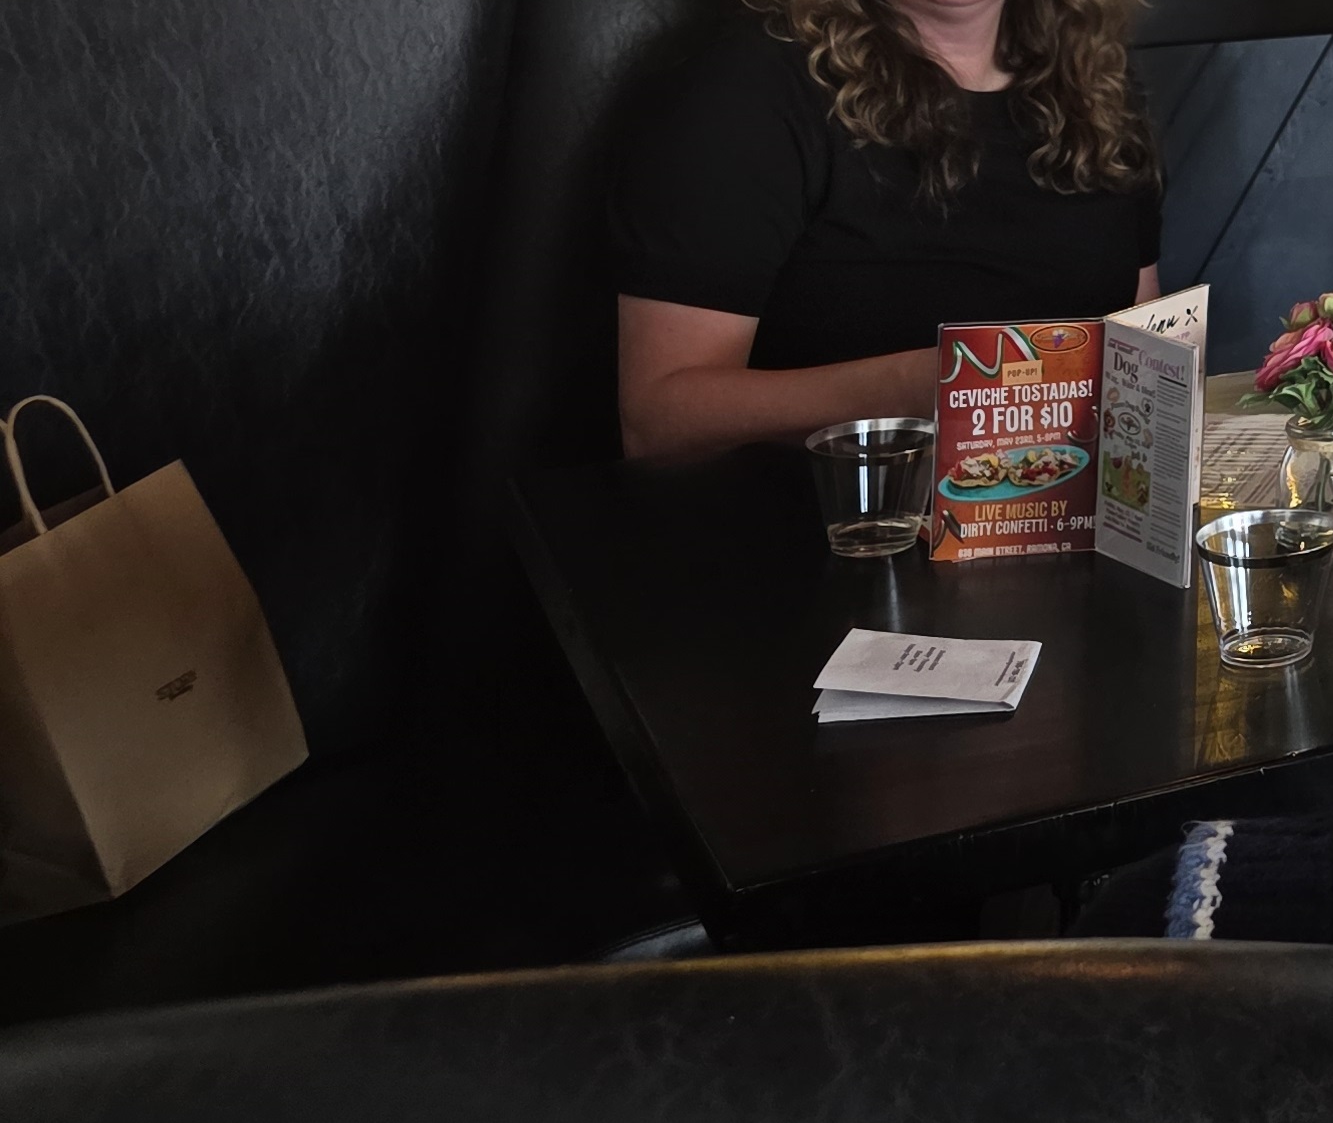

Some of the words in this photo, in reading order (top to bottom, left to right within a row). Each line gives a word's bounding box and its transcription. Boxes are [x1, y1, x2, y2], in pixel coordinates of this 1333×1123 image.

[1113, 352, 1139, 383] Dog
[1139, 349, 1184, 381] Contest!
[949, 385, 1009, 408] CEVICHE
[1013, 379, 1093, 403] TOSTADAS!
[972, 410, 985, 436] 2
[993, 405, 1034, 434] FOR
[1040, 401, 1073, 428] $10
[974, 504, 1003, 522] LIVE
[1006, 501, 1048, 519] MUSIC
[1051, 500, 1068, 517] BY
[960, 521, 992, 539] DIRTY
[995, 518, 1048, 535] CONFETTI
